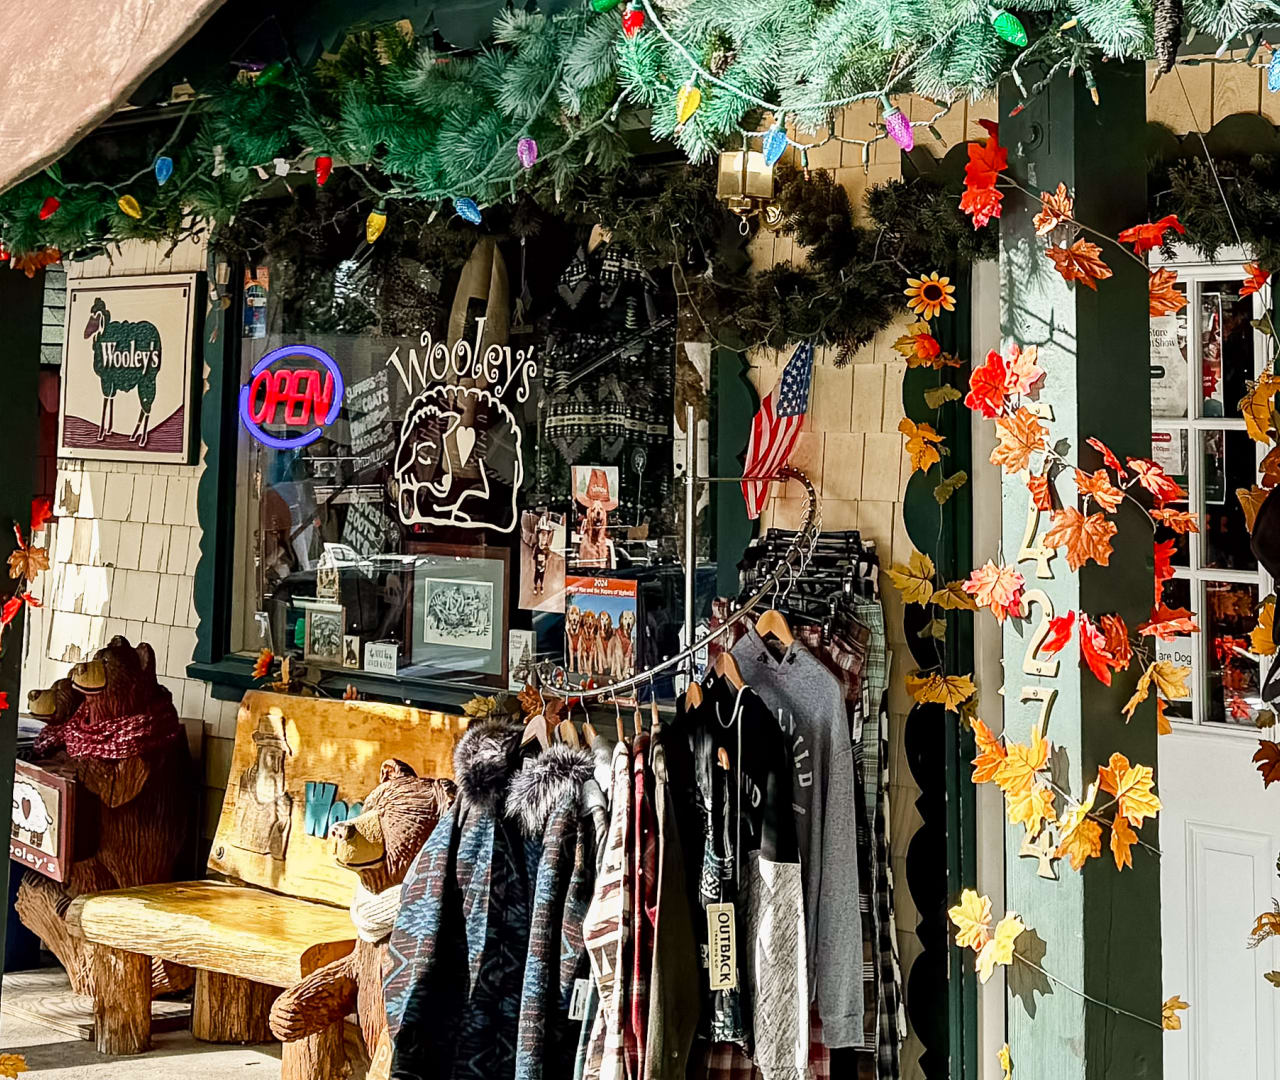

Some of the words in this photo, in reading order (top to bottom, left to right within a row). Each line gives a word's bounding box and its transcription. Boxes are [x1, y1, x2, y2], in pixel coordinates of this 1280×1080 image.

[101, 340, 160, 375] Wooley's
[386, 317, 538, 402] Wooley's
[249, 369, 333, 426] OPEN
[1175, 651, 1192, 665] Dog
[718, 912, 731, 984] OUTBACK
